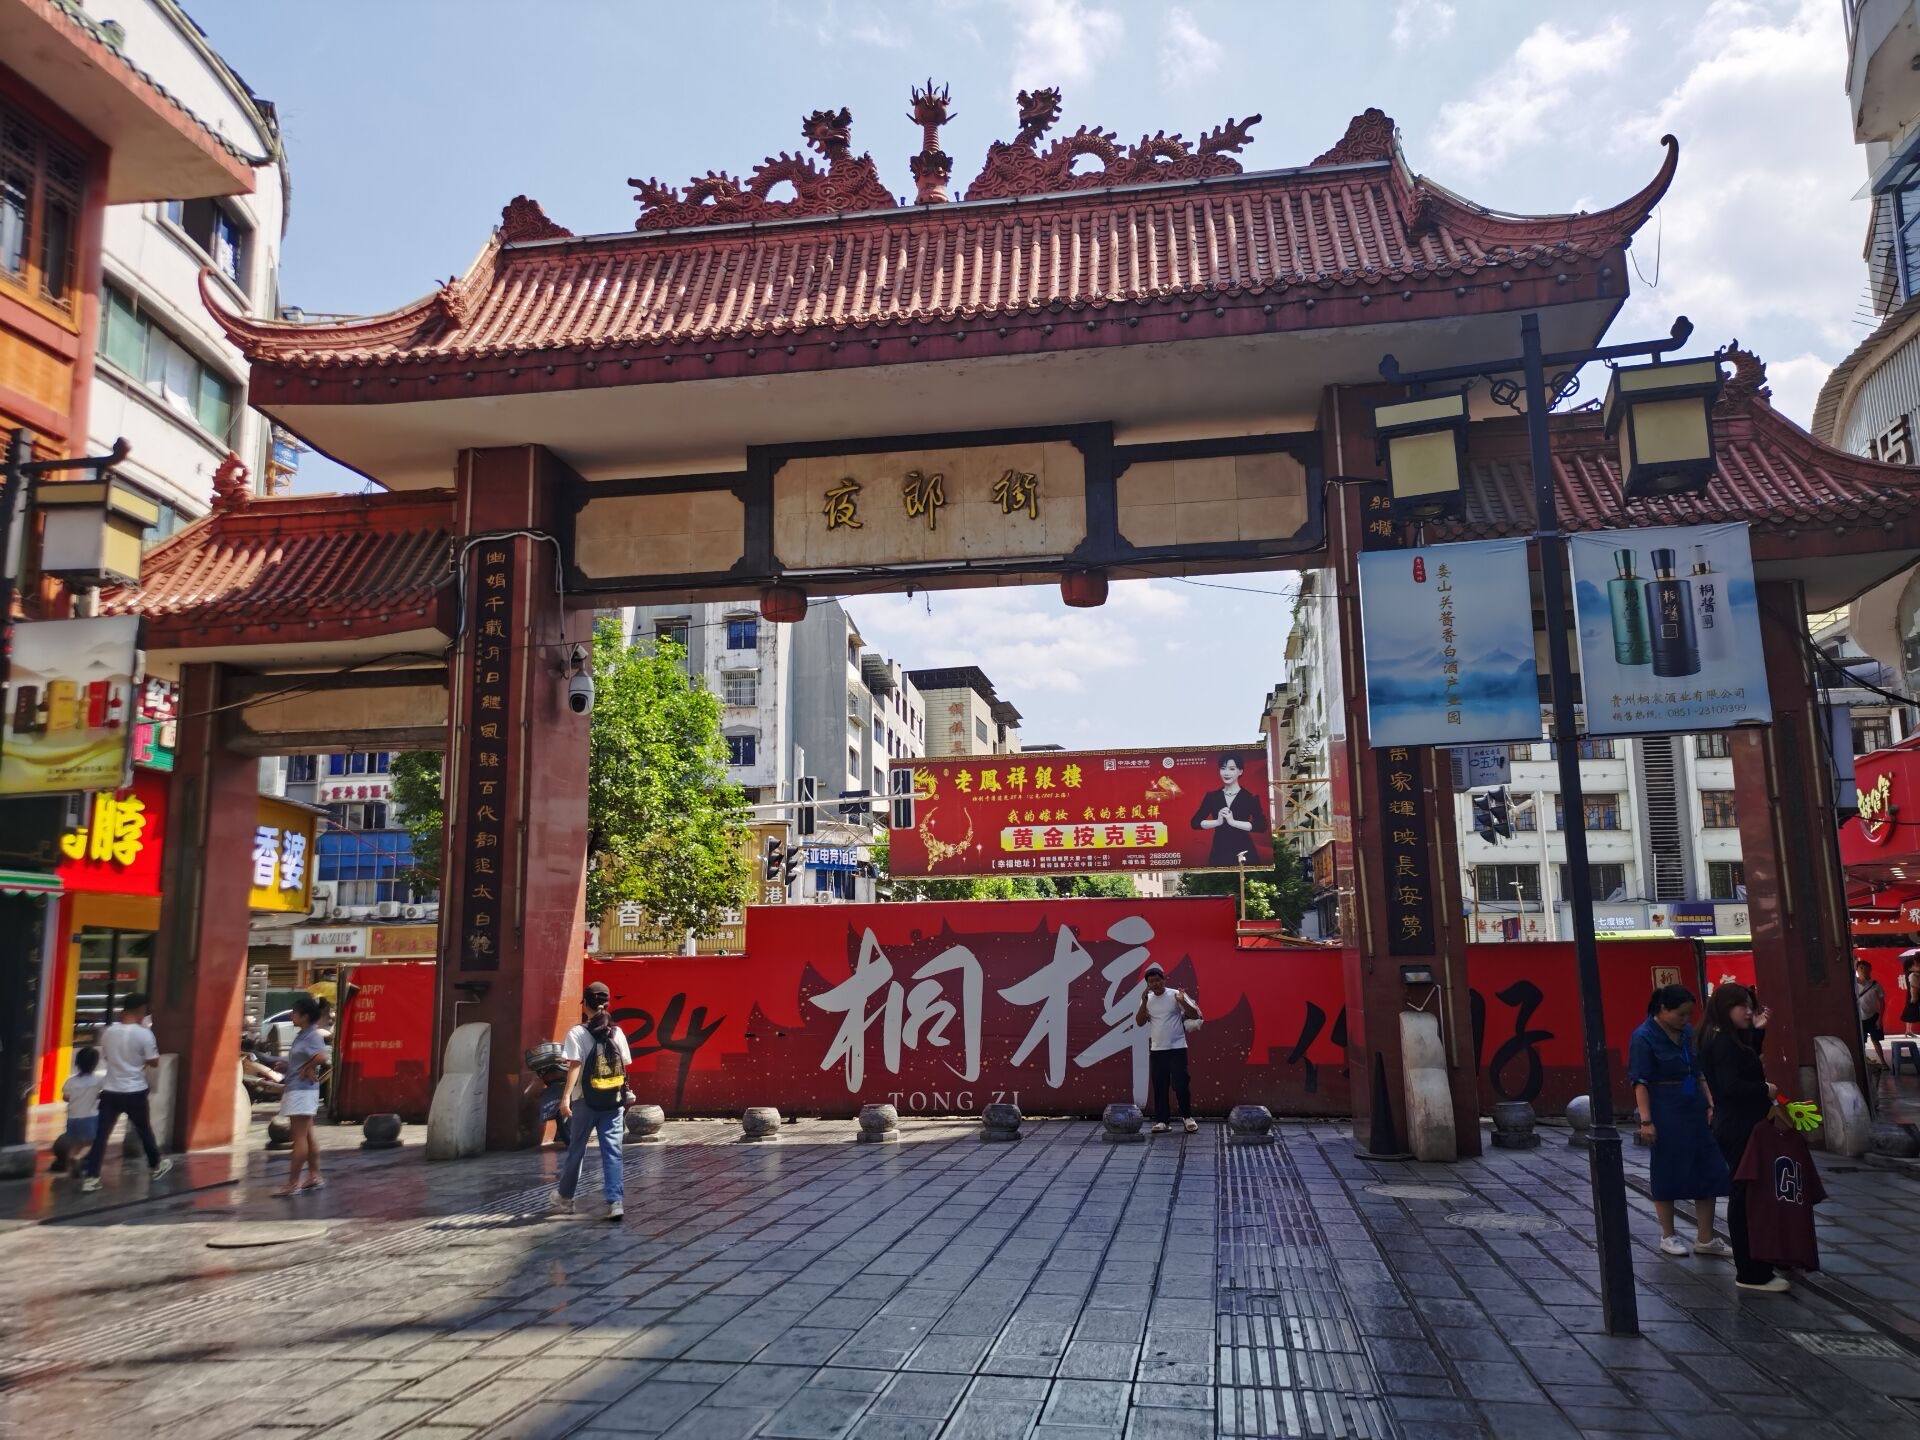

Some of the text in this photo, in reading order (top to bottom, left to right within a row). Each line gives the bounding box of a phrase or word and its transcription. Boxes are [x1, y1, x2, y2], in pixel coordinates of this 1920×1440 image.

[822, 469, 1037, 532] 夜郎街
[954, 763, 1083, 794] 老鳳祥銀樓
[60, 792, 147, 866] 脖
[1007, 808, 1070, 825] 我的嫁妆
[1012, 824, 1158, 850] 黄金按克卖
[1149, 852, 1182, 860] 28850066
[1149, 859, 1182, 867] 26659307
[809, 915, 1156, 1111] 桐梓
[888, 1090, 1021, 1111] TONG ZI
